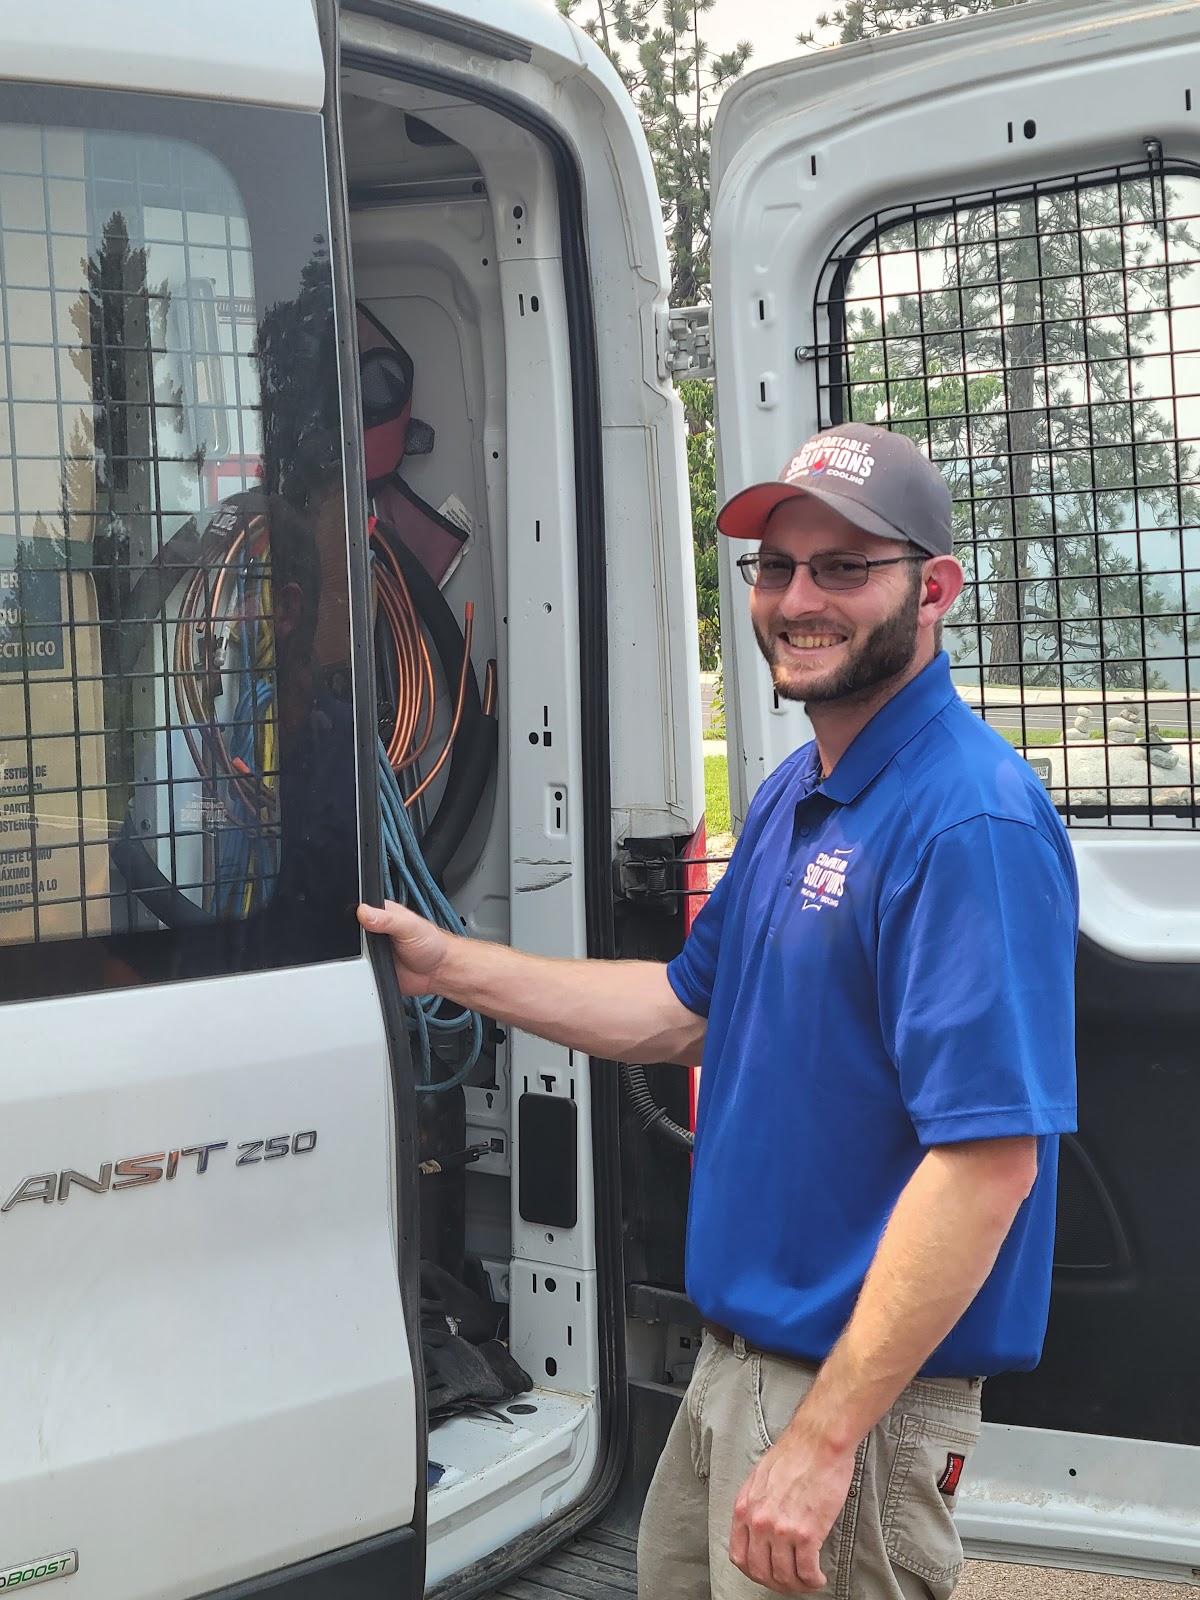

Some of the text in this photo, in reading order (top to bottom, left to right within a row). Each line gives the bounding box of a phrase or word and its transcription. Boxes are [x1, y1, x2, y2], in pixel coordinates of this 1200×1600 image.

[786, 447, 874, 477] SOLUTIONS
[826, 469, 864, 485] COOLING
[35, 765, 47, 777] DE
[38, 880, 45, 893] A
[46, 878, 58, 892] LO
[235, 1130, 318, 1167] 250
